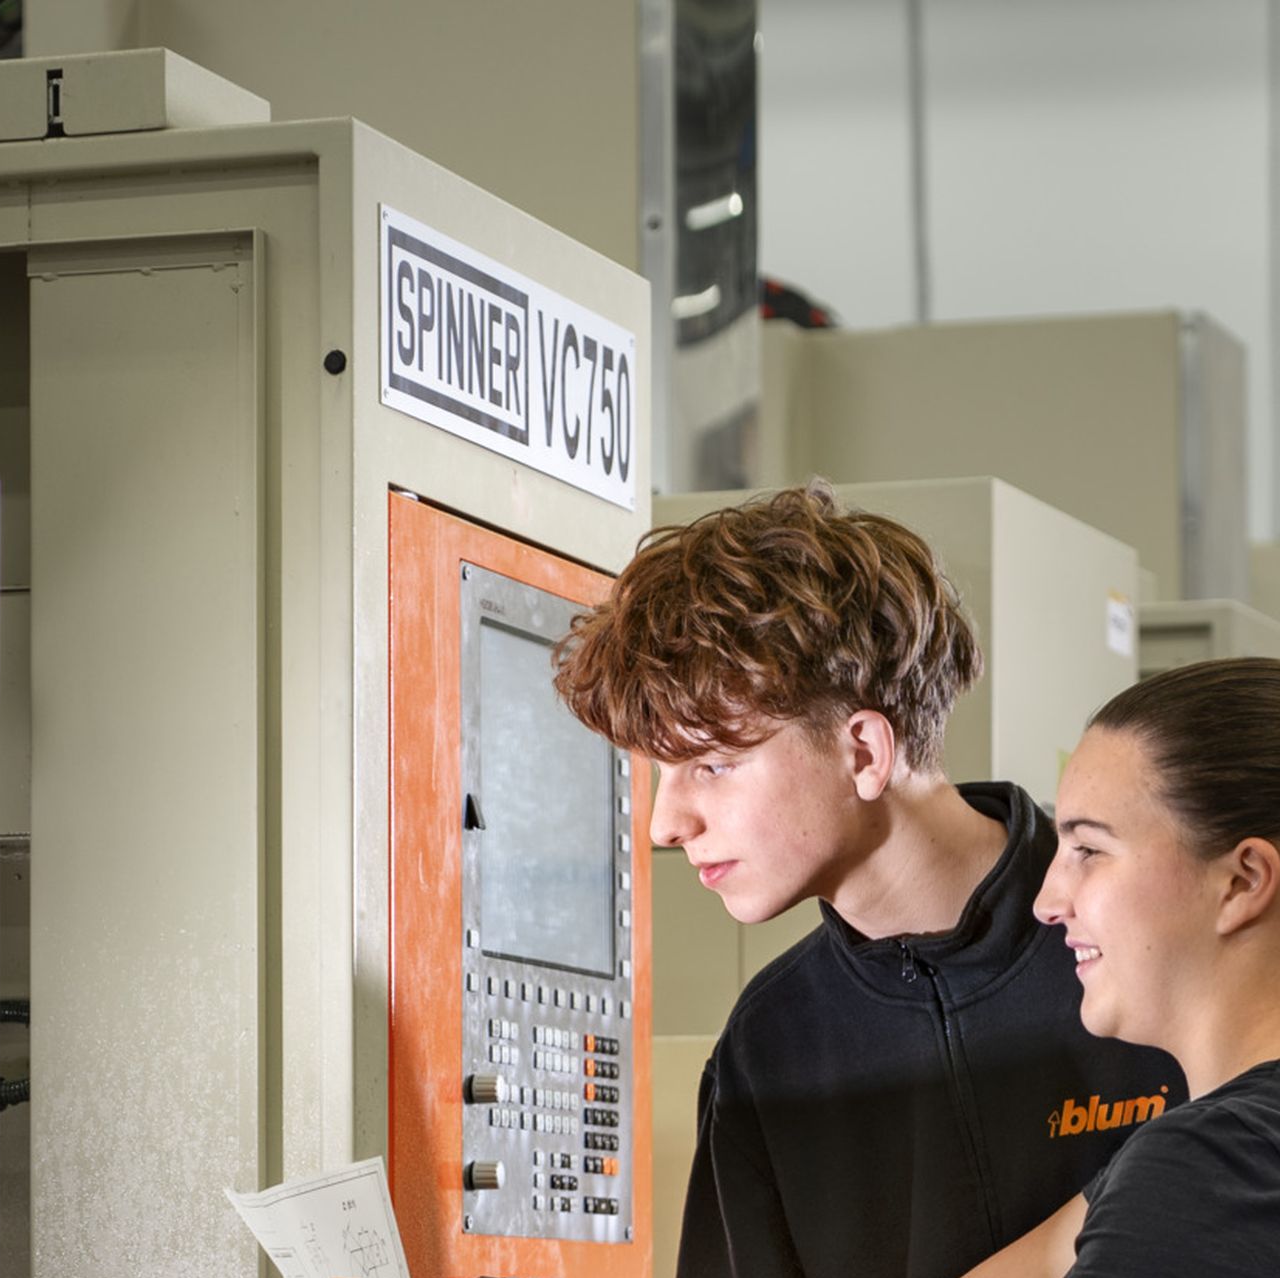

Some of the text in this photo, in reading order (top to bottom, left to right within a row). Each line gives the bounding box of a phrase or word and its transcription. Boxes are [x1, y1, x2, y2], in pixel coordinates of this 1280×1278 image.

[396, 259, 631, 483] SPINNER VC750
[1058, 1093, 1168, 1137] blum
